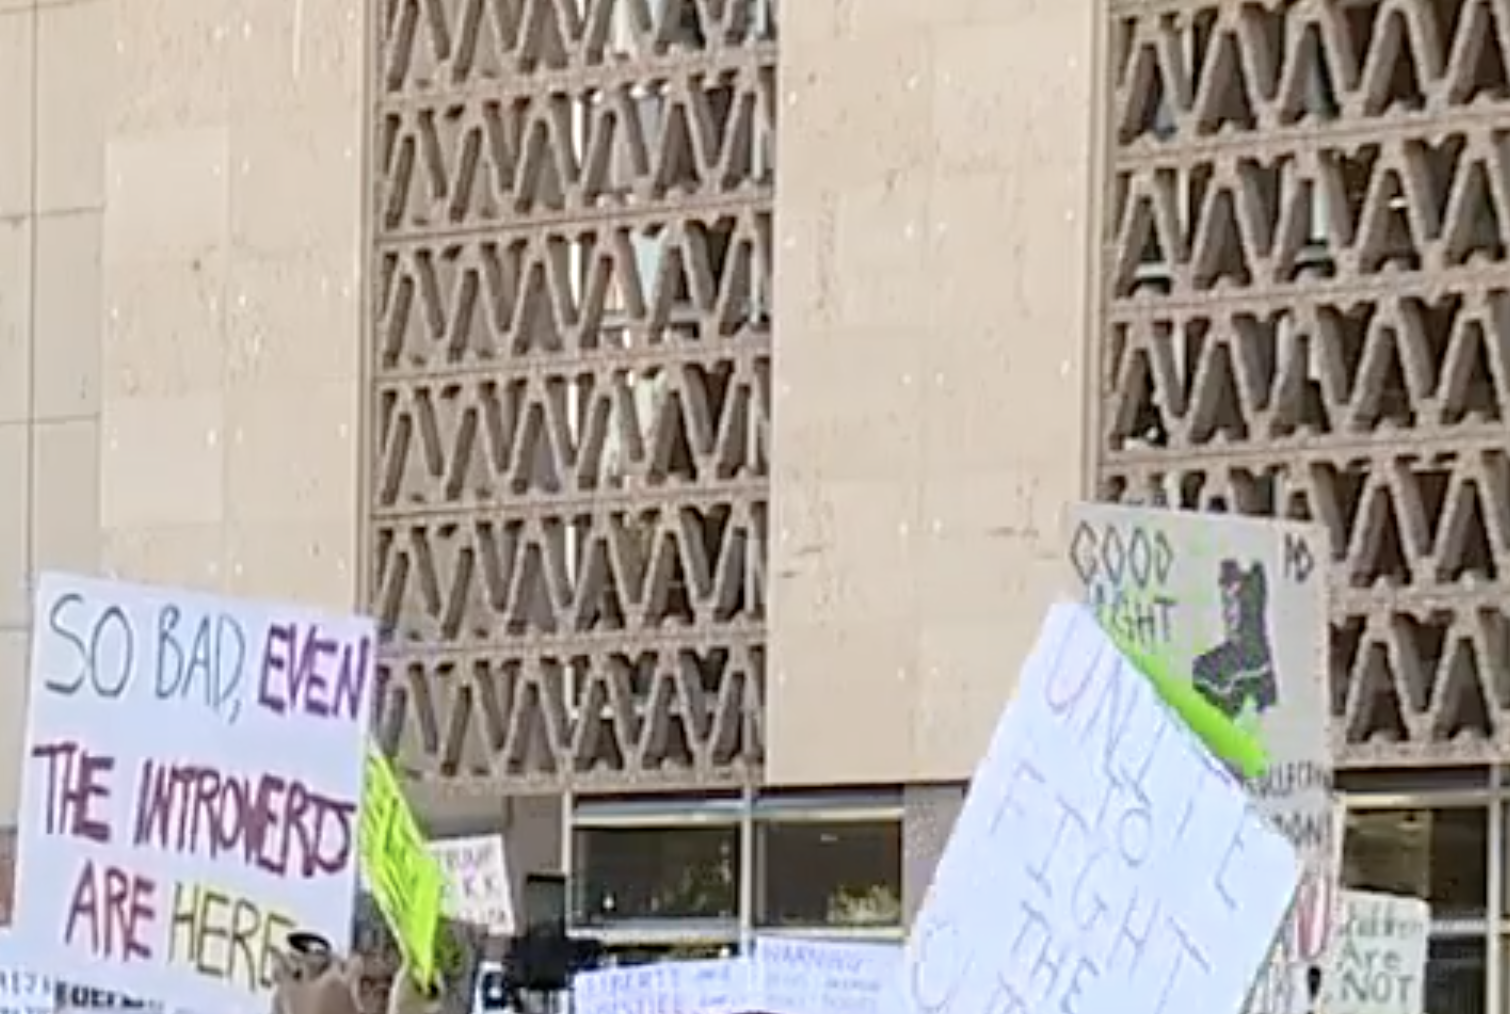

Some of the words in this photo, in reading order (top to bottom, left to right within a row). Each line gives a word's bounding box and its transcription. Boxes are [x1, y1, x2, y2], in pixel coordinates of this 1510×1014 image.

[1069, 519, 1174, 588] GOOD
[45, 592, 134, 699] SO
[154, 604, 247, 723] BAD,
[257, 622, 373, 721] EVEN
[32, 741, 116, 845] THE
[132, 756, 358, 879] INTROVERTS
[1044, 604, 1268, 913] UNITE
[65, 859, 157, 961] ARE
[167, 880, 295, 992] HERE
[1342, 971, 1414, 1002] NOT
